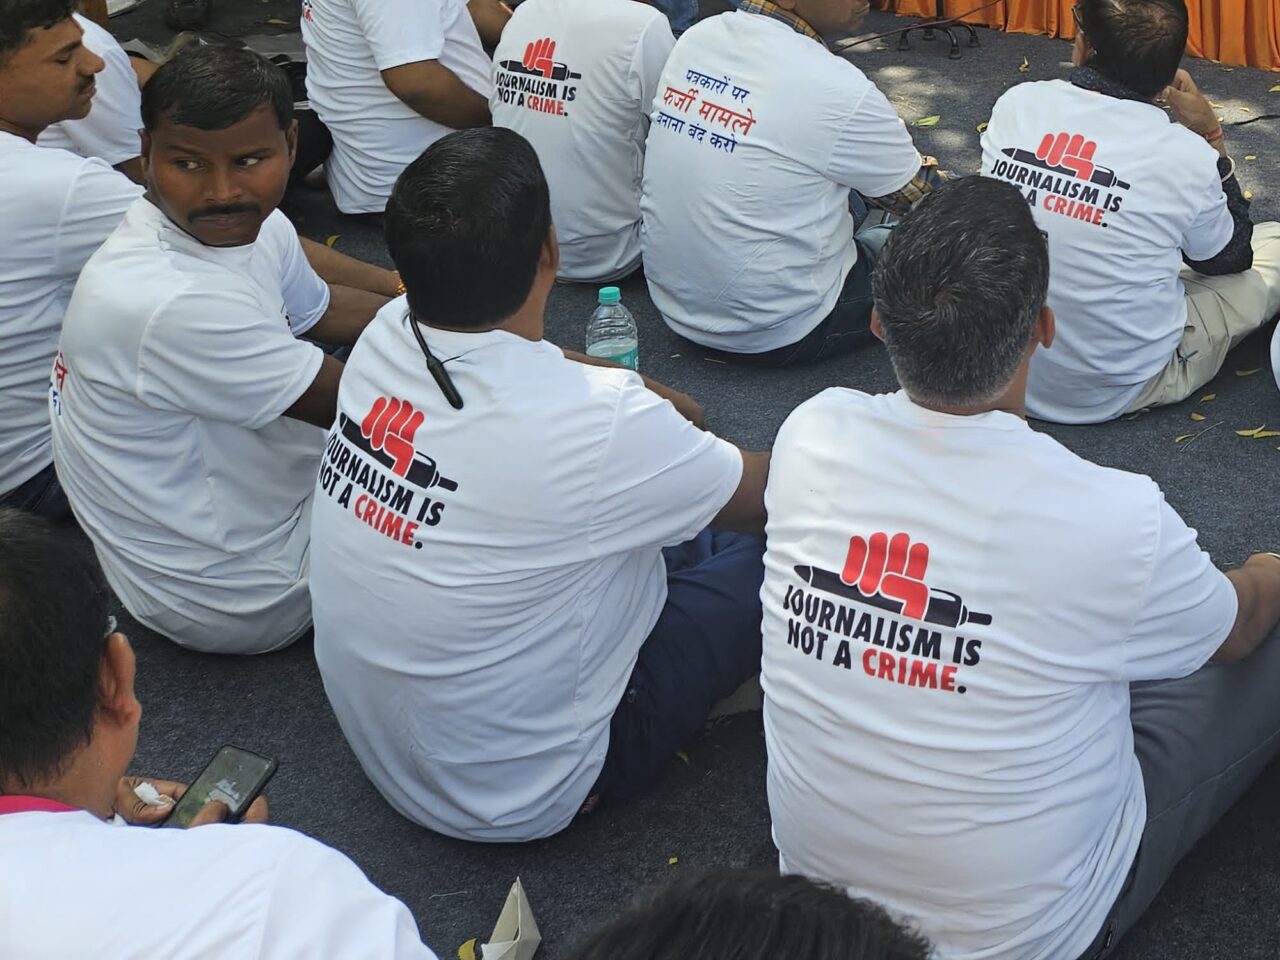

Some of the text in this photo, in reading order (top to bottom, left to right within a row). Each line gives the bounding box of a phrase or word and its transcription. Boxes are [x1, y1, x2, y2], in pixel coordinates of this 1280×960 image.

[496, 72, 576, 101] JOURNALISM IS
[497, 87, 568, 116] NOT A CRIME.
[663, 86, 756, 135] फर्जी मामले
[686, 69, 750, 103] पत्रकारों पर
[656, 111, 738, 153] बनाना बंद करो
[991, 159, 1123, 212] JOURNALISM IS
[1026, 189, 1109, 228] A CRIME.
[327, 428, 445, 526] OURNALISM IS
[337, 483, 354, 509] A
[354, 494, 423, 549] CRIME.
[783, 585, 982, 666] JOURNALISM IS
[787, 618, 967, 694] NOT A CRIME.
